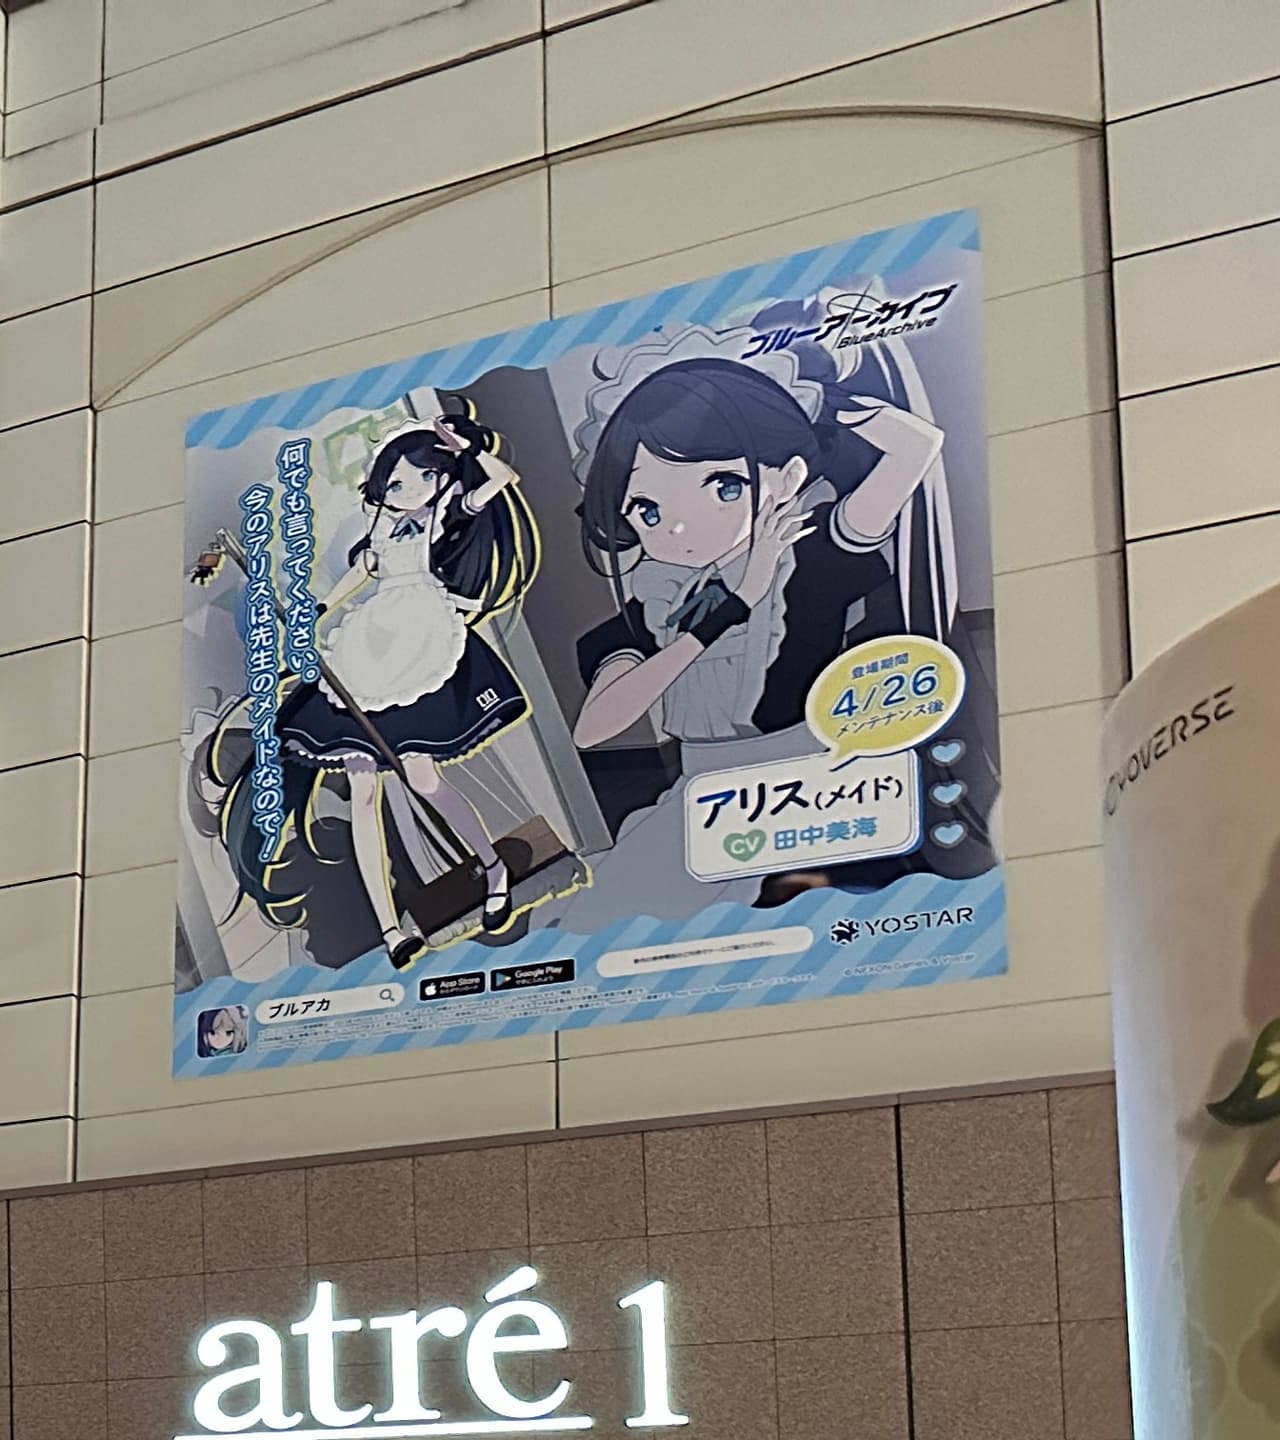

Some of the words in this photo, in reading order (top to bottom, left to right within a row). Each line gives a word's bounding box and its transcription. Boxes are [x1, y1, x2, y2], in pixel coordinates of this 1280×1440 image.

[282, 443, 318, 683] 何でも言ってください。
[831, 665, 937, 718] 4/26
[1103, 685, 1236, 817] OYOVERSE
[773, 816, 879, 850] 田中美海
[864, 906, 974, 937] YOSTAR
[269, 997, 331, 1020] ブルアカ
[192, 1264, 572, 1434] atré
